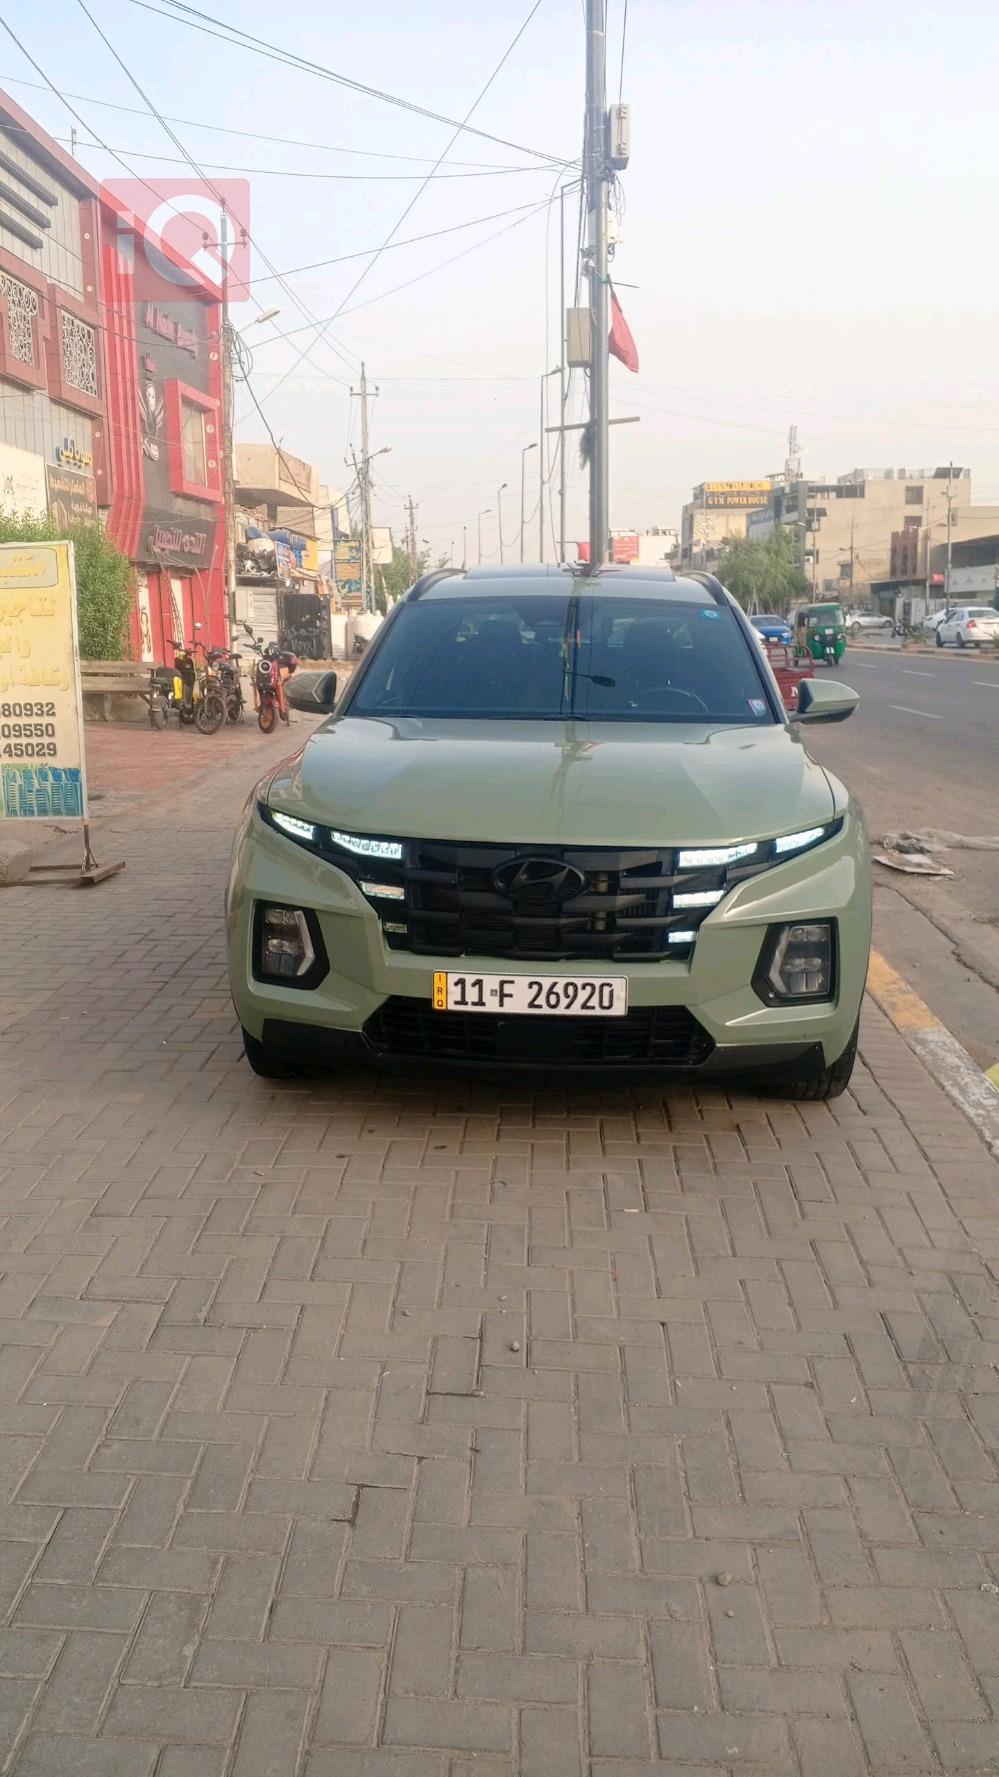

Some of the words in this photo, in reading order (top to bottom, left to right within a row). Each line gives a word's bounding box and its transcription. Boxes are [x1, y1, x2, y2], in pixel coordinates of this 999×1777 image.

[0, 702, 56, 718] 80932
[0, 723, 56, 739] 09550
[0, 742, 57, 757] 45029
[453, 977, 487, 1007] 11
[498, 979, 515, 1008] F
[527, 981, 614, 1010] 26920
